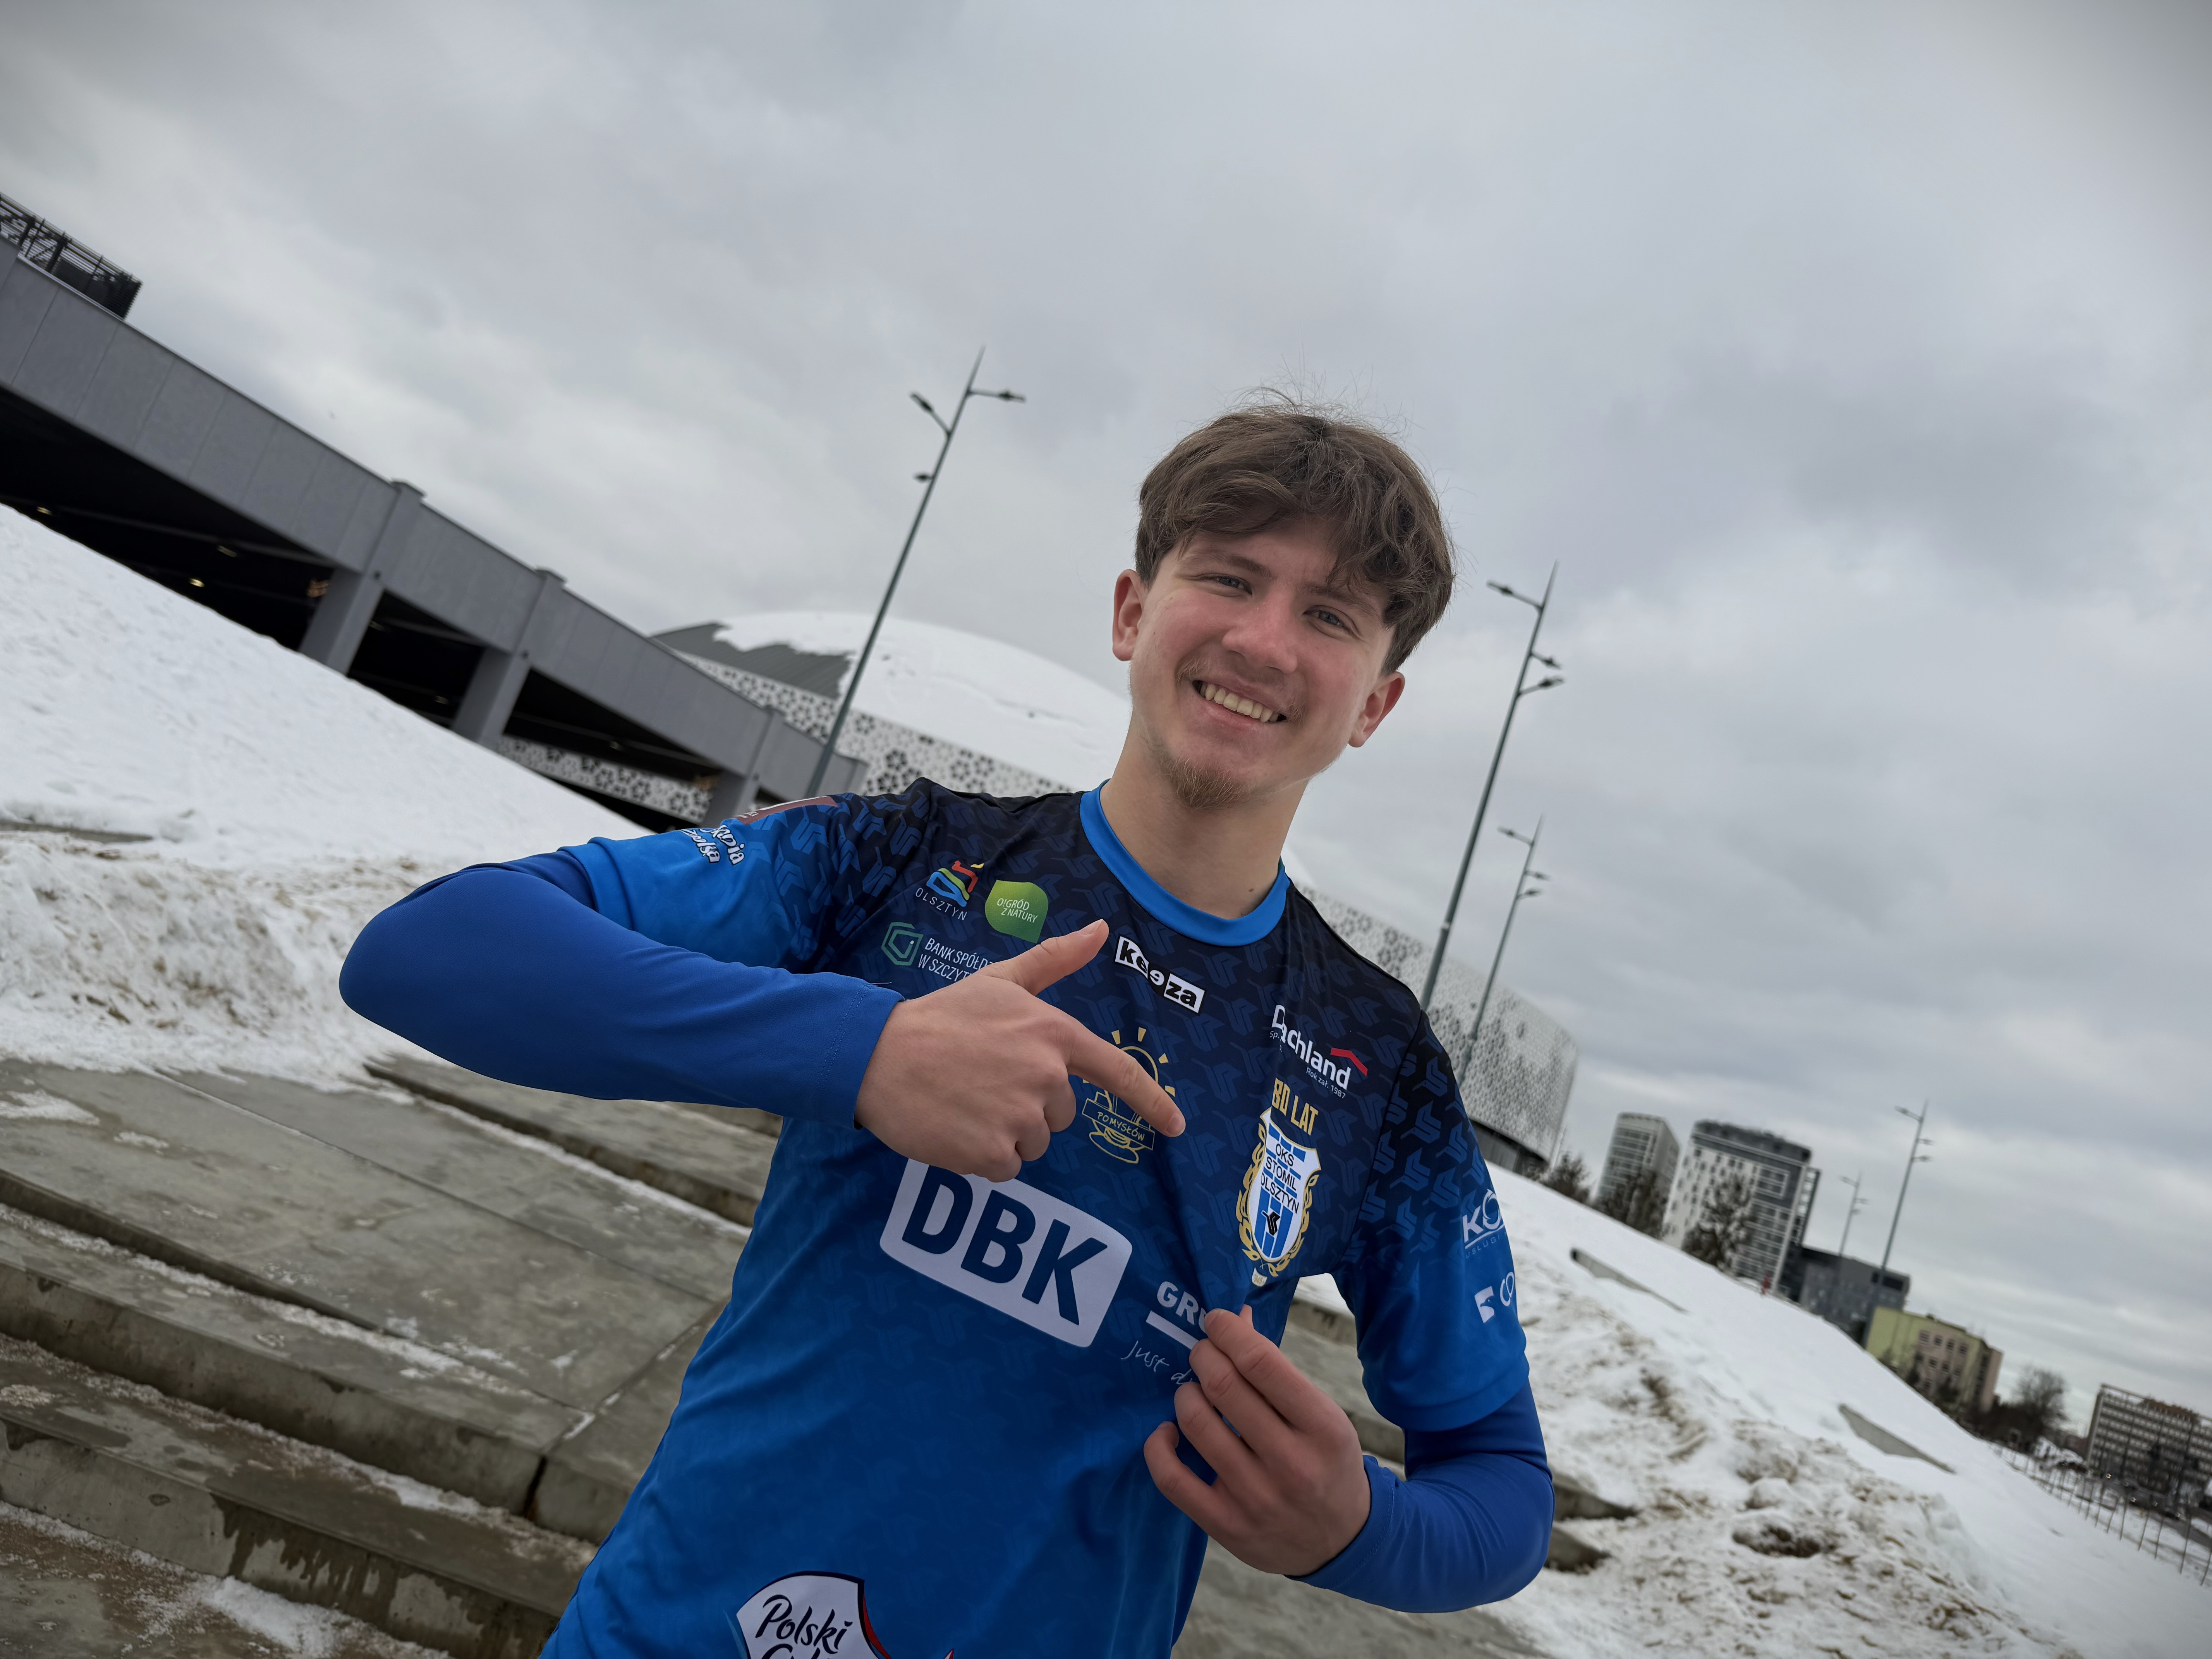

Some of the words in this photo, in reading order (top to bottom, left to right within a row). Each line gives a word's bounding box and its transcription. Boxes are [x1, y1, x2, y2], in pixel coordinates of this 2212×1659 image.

[915, 887, 967, 921] OLSZTYN
[997, 898, 1030, 910] O!GRÓD
[1007, 908, 1038, 923] NATURY
[918, 954, 931, 969] W
[929, 959, 973, 982] SZCZYT
[925, 938, 955, 961] BANK
[953, 951, 994, 970] SPÓŁD
[1306, 1067, 1317, 1080] Rok
[1331, 1085, 1346, 1099] 1987
[1097, 1111, 1145, 1141] POMYSŁÓW
[1290, 1095, 1319, 1136] LAT
[1275, 1143, 1294, 1167] OKS
[1266, 1156, 1297, 1192] STOMIL
[1261, 1172, 1300, 1214] OLSZTYN
[902, 1164, 1108, 1326] DBK
[755, 1594, 853, 1654] Polski
